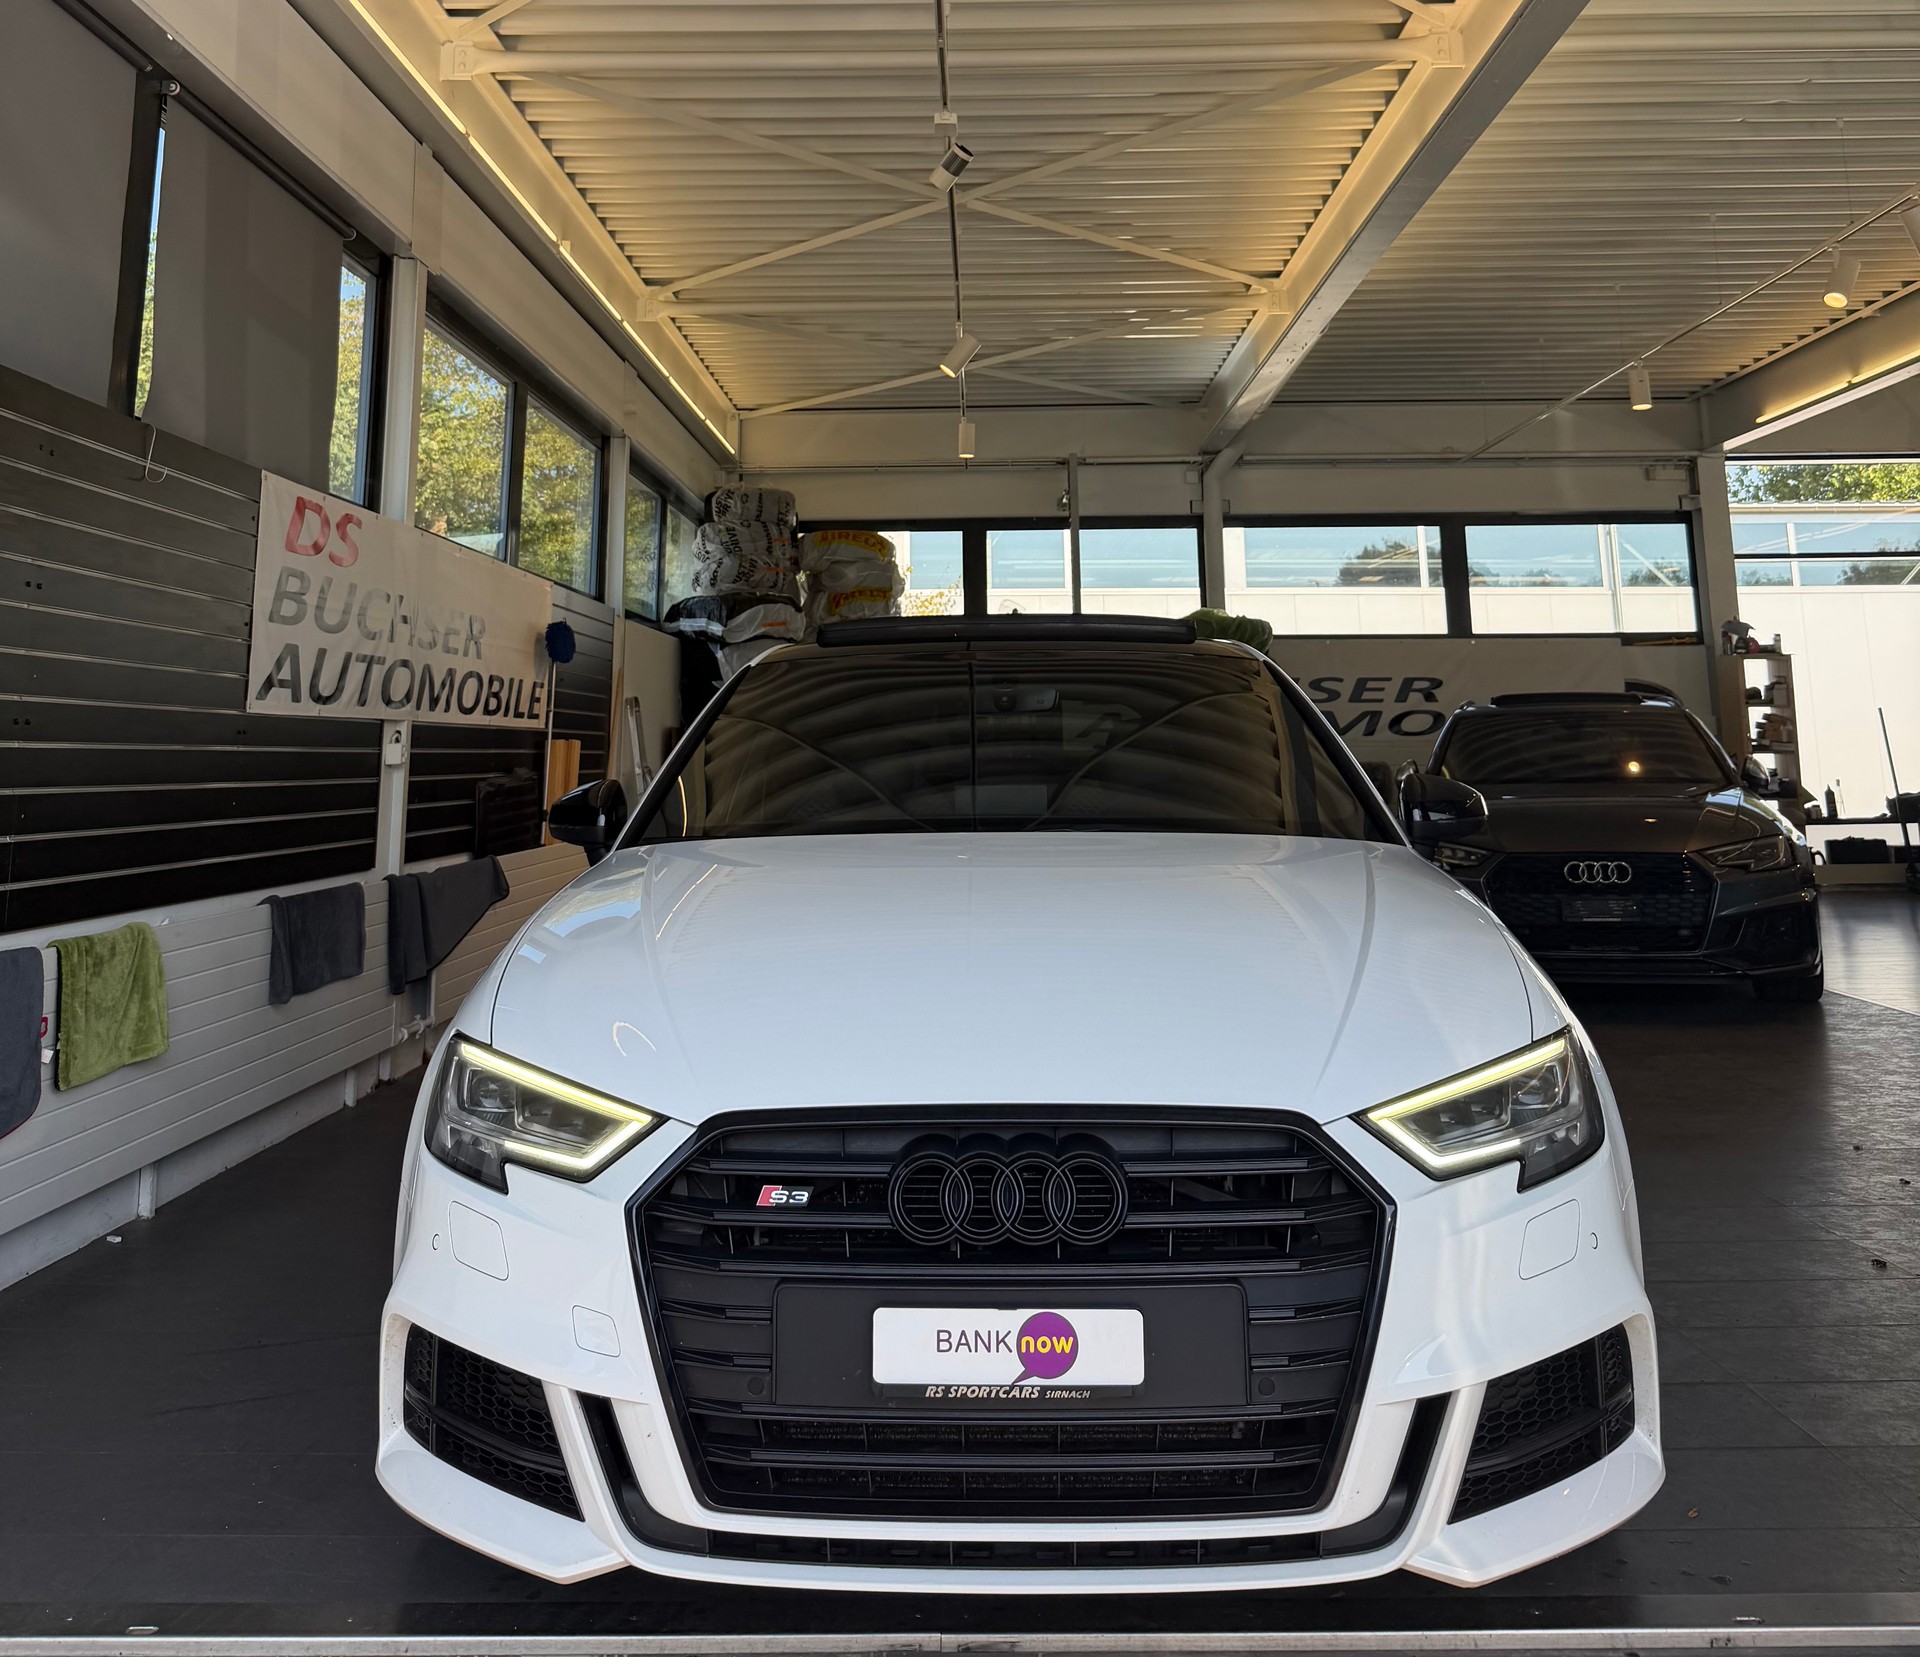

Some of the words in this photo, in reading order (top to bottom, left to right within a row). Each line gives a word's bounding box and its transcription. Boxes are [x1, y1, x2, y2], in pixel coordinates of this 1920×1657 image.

[285, 496, 362, 567] DS
[268, 566, 486, 660] BUCHSER
[255, 643, 544, 719] AUTOMOBILE
[1293, 677, 1444, 703] SER
[770, 1190, 808, 1204] S3
[936, 1330, 1013, 1353] BANK
[1020, 1335, 1074, 1354] now
[925, 1386, 944, 1398] RS
[948, 1385, 1041, 1399] SPORTCARS
[1045, 1389, 1091, 1399] SIRNACH
